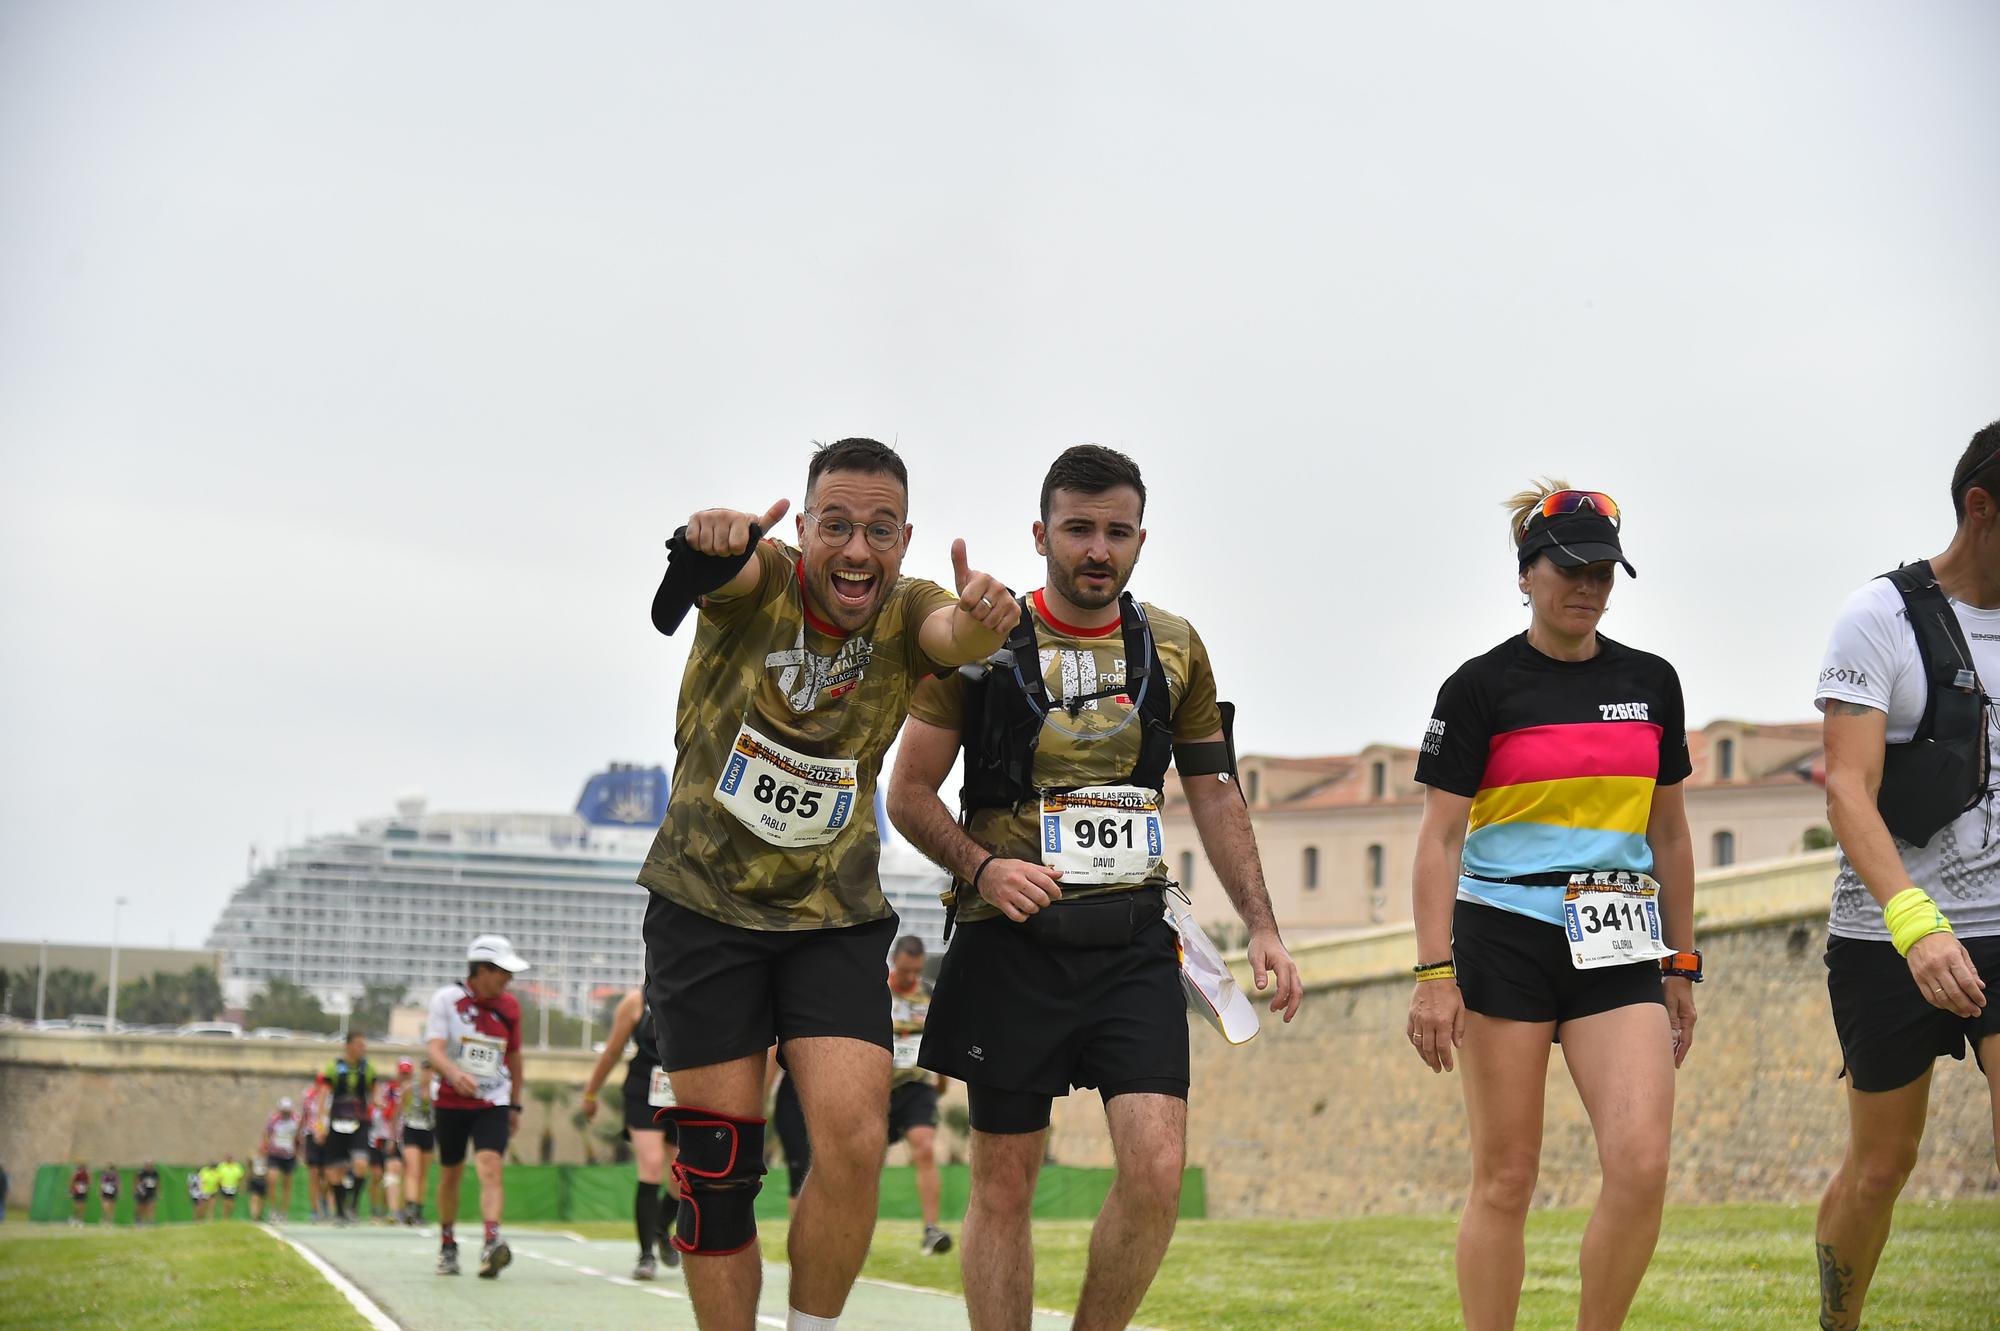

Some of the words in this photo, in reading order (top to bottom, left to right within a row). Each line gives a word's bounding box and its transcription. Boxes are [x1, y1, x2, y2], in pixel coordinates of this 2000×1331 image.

[1599, 703, 1648, 720] 226ERS
[794, 761, 809, 772] LAS
[725, 766, 741, 791] CAJON
[808, 770, 842, 783] 2023
[754, 774, 822, 818] 865
[1092, 792, 1100, 801] DE
[1118, 797, 1144, 807] 2023
[832, 801, 845, 826] CAJON
[761, 814, 786, 832] PABLO
[1075, 819, 1133, 849] 961
[1150, 826, 1158, 854] CAJON
[1093, 857, 1115, 868] DAVID
[1620, 883, 1641, 893] 2023
[1567, 913, 1578, 940] CAJON
[1581, 903, 1646, 933] 3411
[1612, 940, 1633, 950] GLORIA
